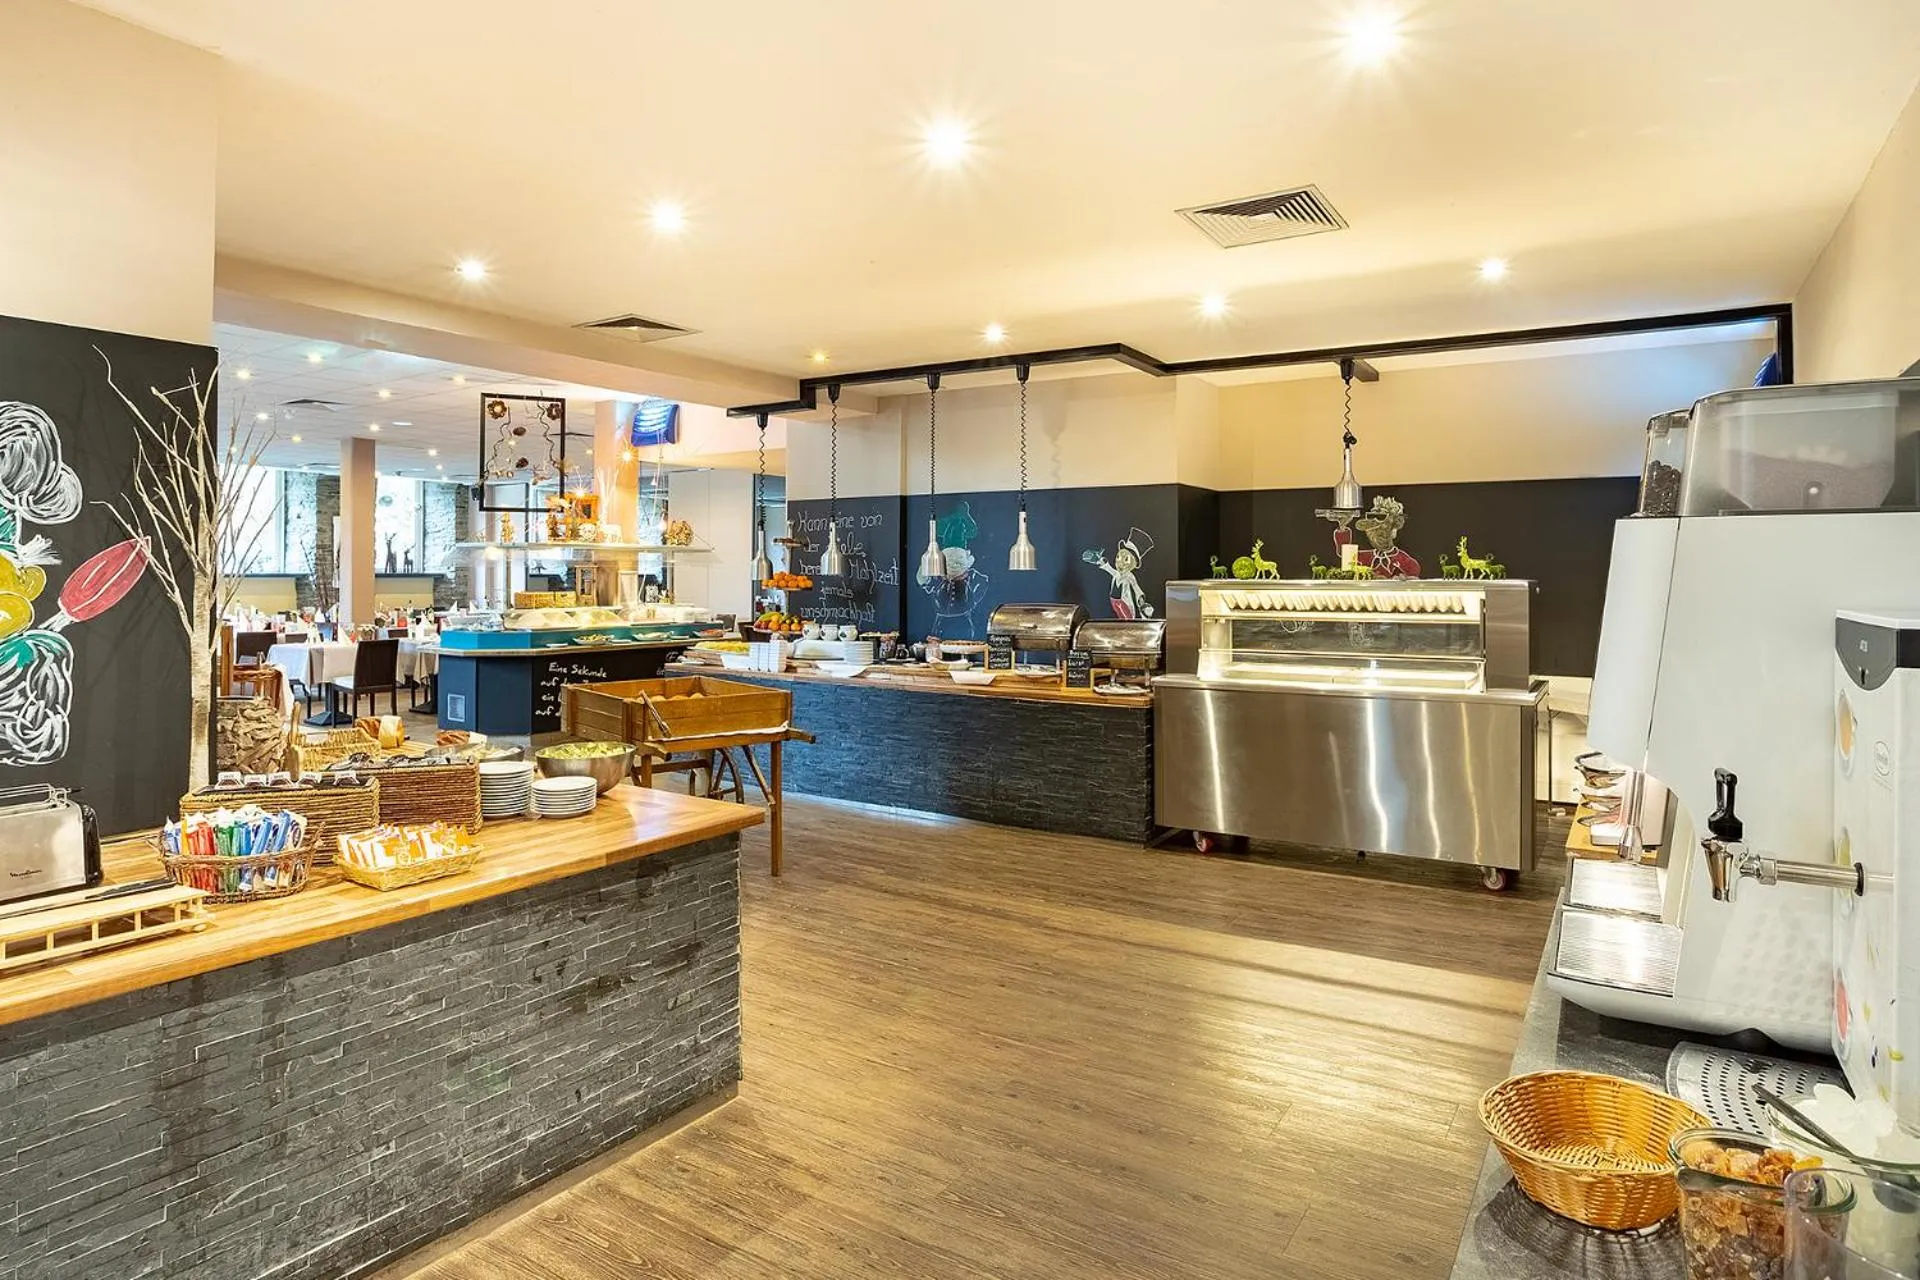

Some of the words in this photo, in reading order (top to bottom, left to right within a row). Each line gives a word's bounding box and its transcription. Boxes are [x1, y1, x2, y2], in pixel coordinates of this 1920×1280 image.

[860, 512, 883, 529] von
[548, 661, 568, 673] Eine
[571, 664, 607, 678] Sekunde
[540, 676, 559, 686] auf
[541, 693, 555, 702] ein
[534, 705, 554, 716] auf
